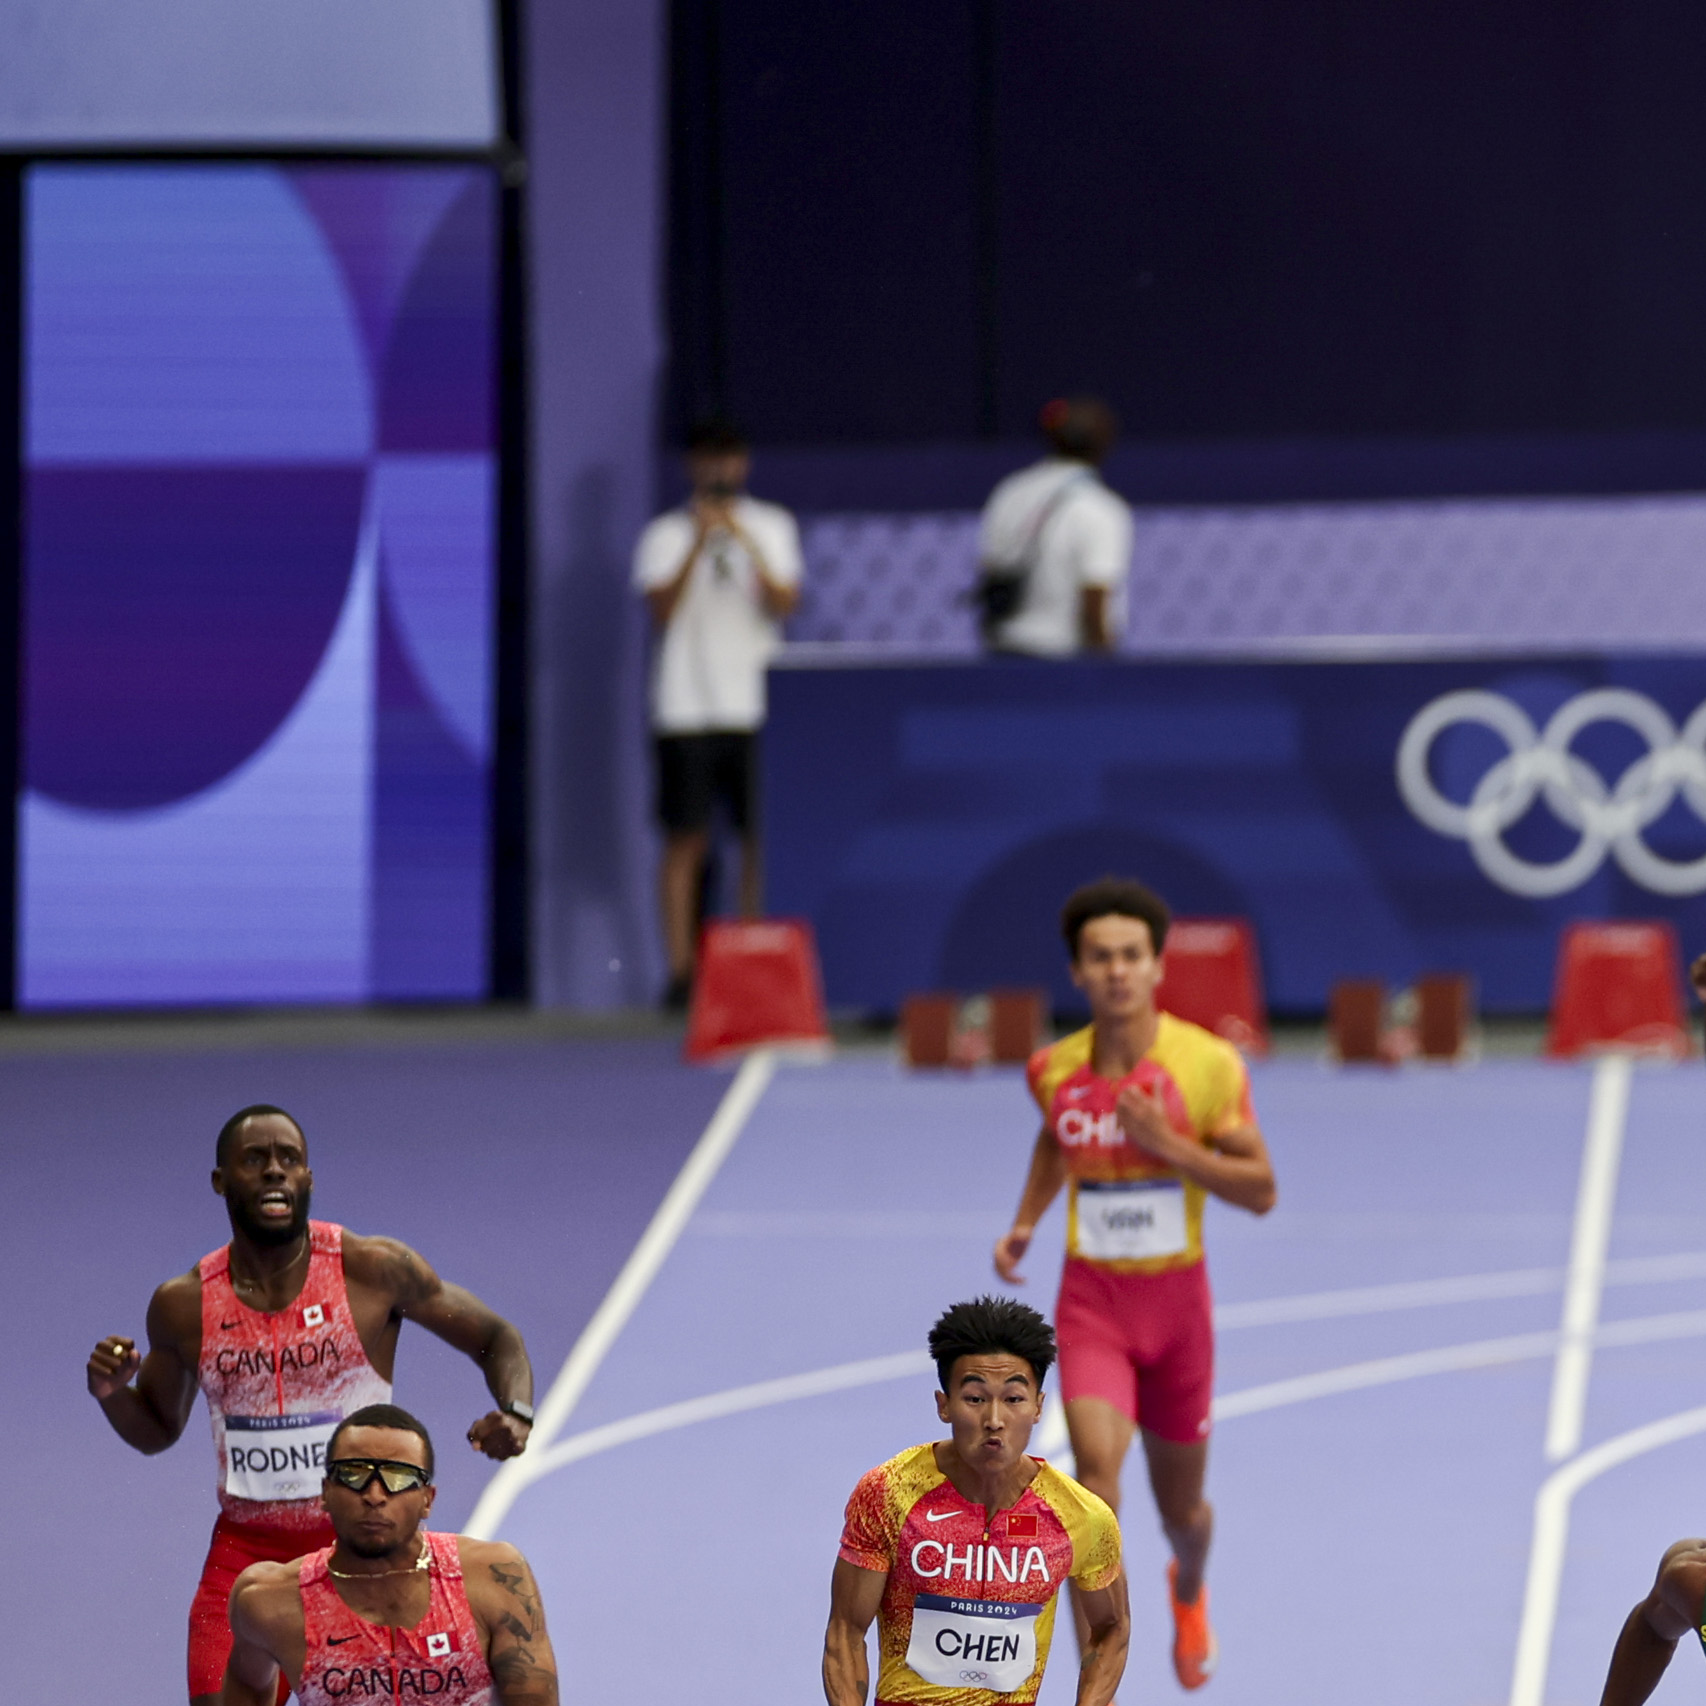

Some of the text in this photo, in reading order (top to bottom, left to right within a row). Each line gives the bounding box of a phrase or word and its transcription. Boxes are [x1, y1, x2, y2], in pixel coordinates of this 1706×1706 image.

[216, 1338, 341, 1377] CANADA
[231, 1442, 325, 1473] RODNE
[910, 1540, 1051, 1583] CHINA
[987, 1604, 1018, 1615] 2024
[935, 1628, 1020, 1662] CHEN
[322, 1665, 468, 1697] CANADA
